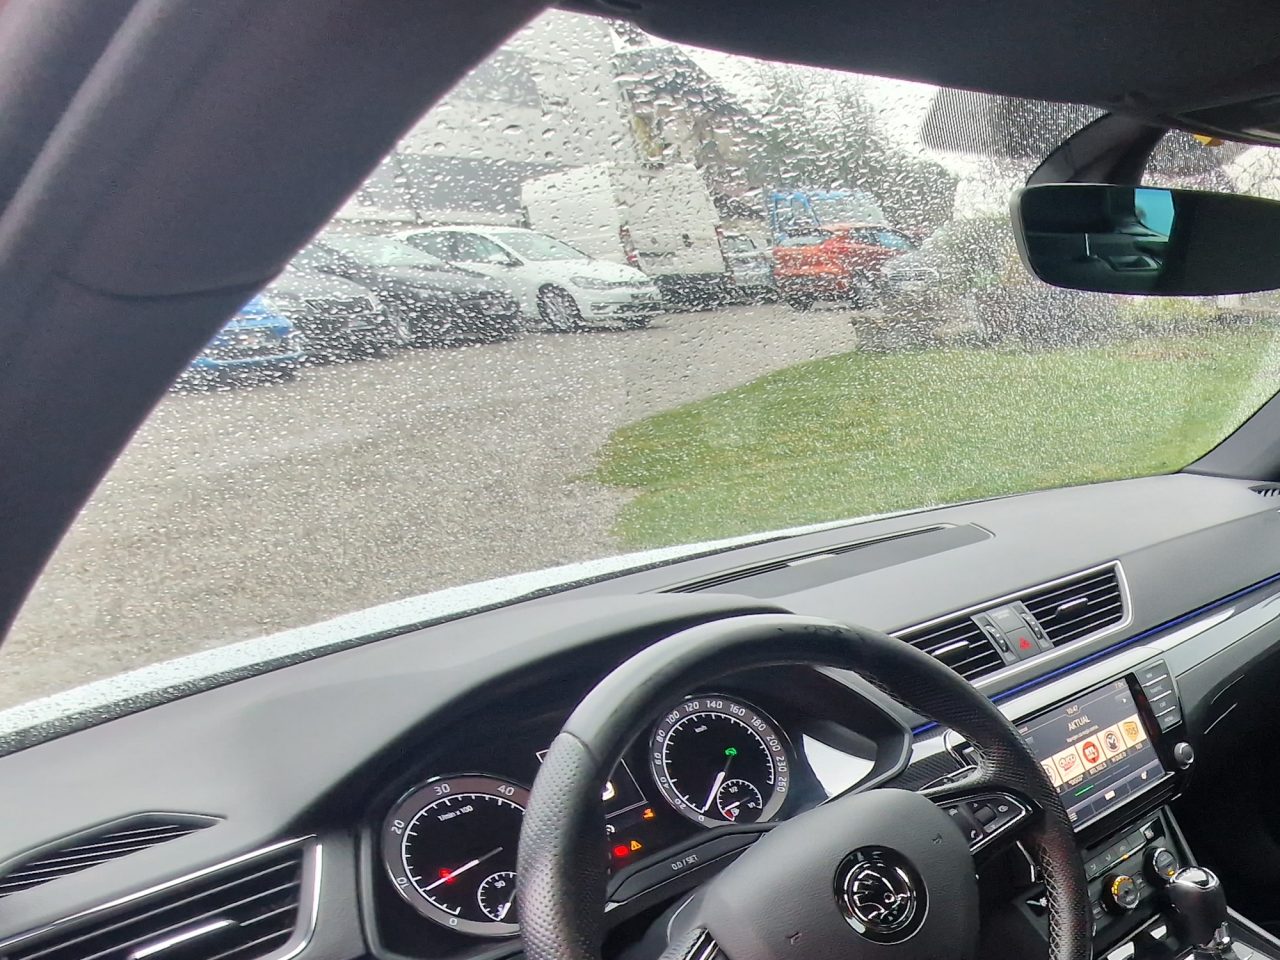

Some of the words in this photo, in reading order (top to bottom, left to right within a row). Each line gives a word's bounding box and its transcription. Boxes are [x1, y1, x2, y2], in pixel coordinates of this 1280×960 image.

[684, 701, 699, 712] 120
[706, 700, 722, 709] 140
[730, 704, 745, 716] 160
[666, 710, 680, 725] 100
[751, 716, 766, 731] 180
[656, 729, 666, 743] 80
[766, 735, 780, 751] 200
[776, 756, 787, 772] 230
[434, 783, 450, 795] 30
[660, 776, 669, 789] 40
[777, 776, 787, 792] 260
[497, 784, 515, 796] 40
[675, 798, 687, 810] 20
[391, 819, 405, 834] 20
[397, 877, 409, 889] 10
